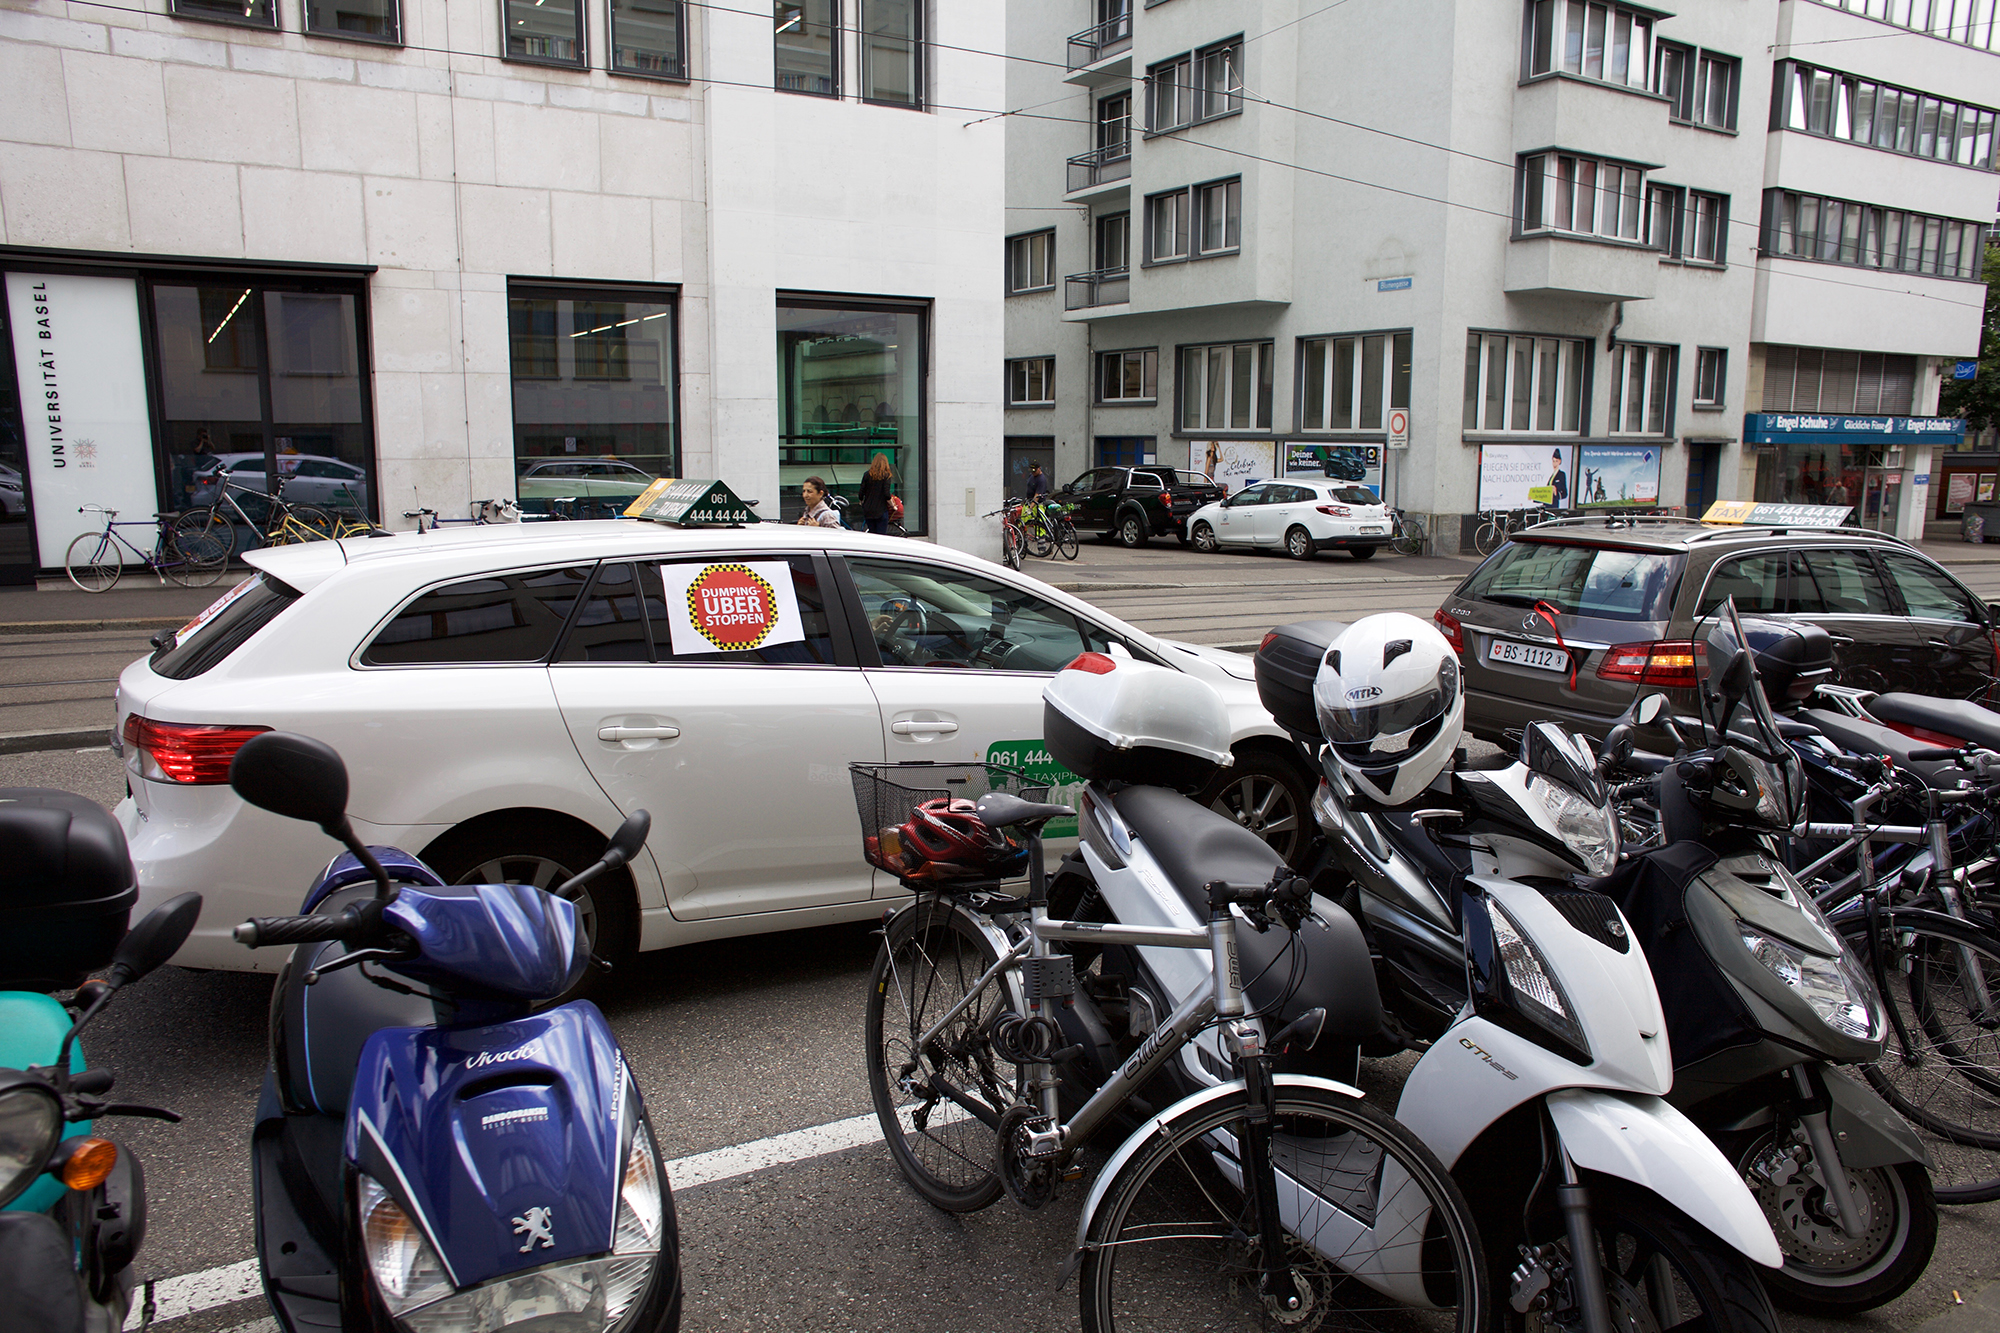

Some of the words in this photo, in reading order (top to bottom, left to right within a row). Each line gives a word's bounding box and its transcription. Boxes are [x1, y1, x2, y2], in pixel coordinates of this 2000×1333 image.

[32, 281, 51, 340] BASEL
[38, 349, 67, 469] UNIVERSITÄT
[1776, 416, 1799, 432] Engel
[1800, 416, 1829, 429] Schuhe
[1844, 420, 1870, 430] Glückliche
[1907, 420, 1926, 434] Engel
[1927, 420, 1952, 431] Schuhe
[1291, 450, 1314, 458] Deiner
[1230, 459, 1256, 470] Celebrate
[1298, 459, 1322, 467] keiner.
[1483, 463, 1508, 471] FLIEGEN
[1509, 463, 1519, 471] SIE
[1520, 463, 1542, 471] DIREKT
[1483, 474, 1501, 482] NACH
[1502, 474, 1530, 482] LONDON
[1530, 474, 1545, 482] CITY
[711, 493, 728, 504] 061
[690, 509, 713, 521] 444
[715, 509, 730, 521] 44
[732, 509, 748, 521] 44
[1712, 508, 1747, 519] TAXI
[1754, 506, 1775, 515] 061
[1775, 506, 1802, 516] 444
[1804, 507, 1824, 516] 44
[1825, 508, 1848, 518] 44
[1777, 516, 1842, 527] TAXIPHON
[701, 586, 762, 598] DUMPING-
[703, 596, 763, 615] UBER
[705, 612, 765, 626] STOPPEN
[990, 750, 1018, 767] 061
[1024, 750, 1054, 765] 444
[1034, 771, 1084, 781] TAXIPH
[465, 1045, 542, 1070] Vivacity
[610, 1047, 622, 1121] SPORTLINE
